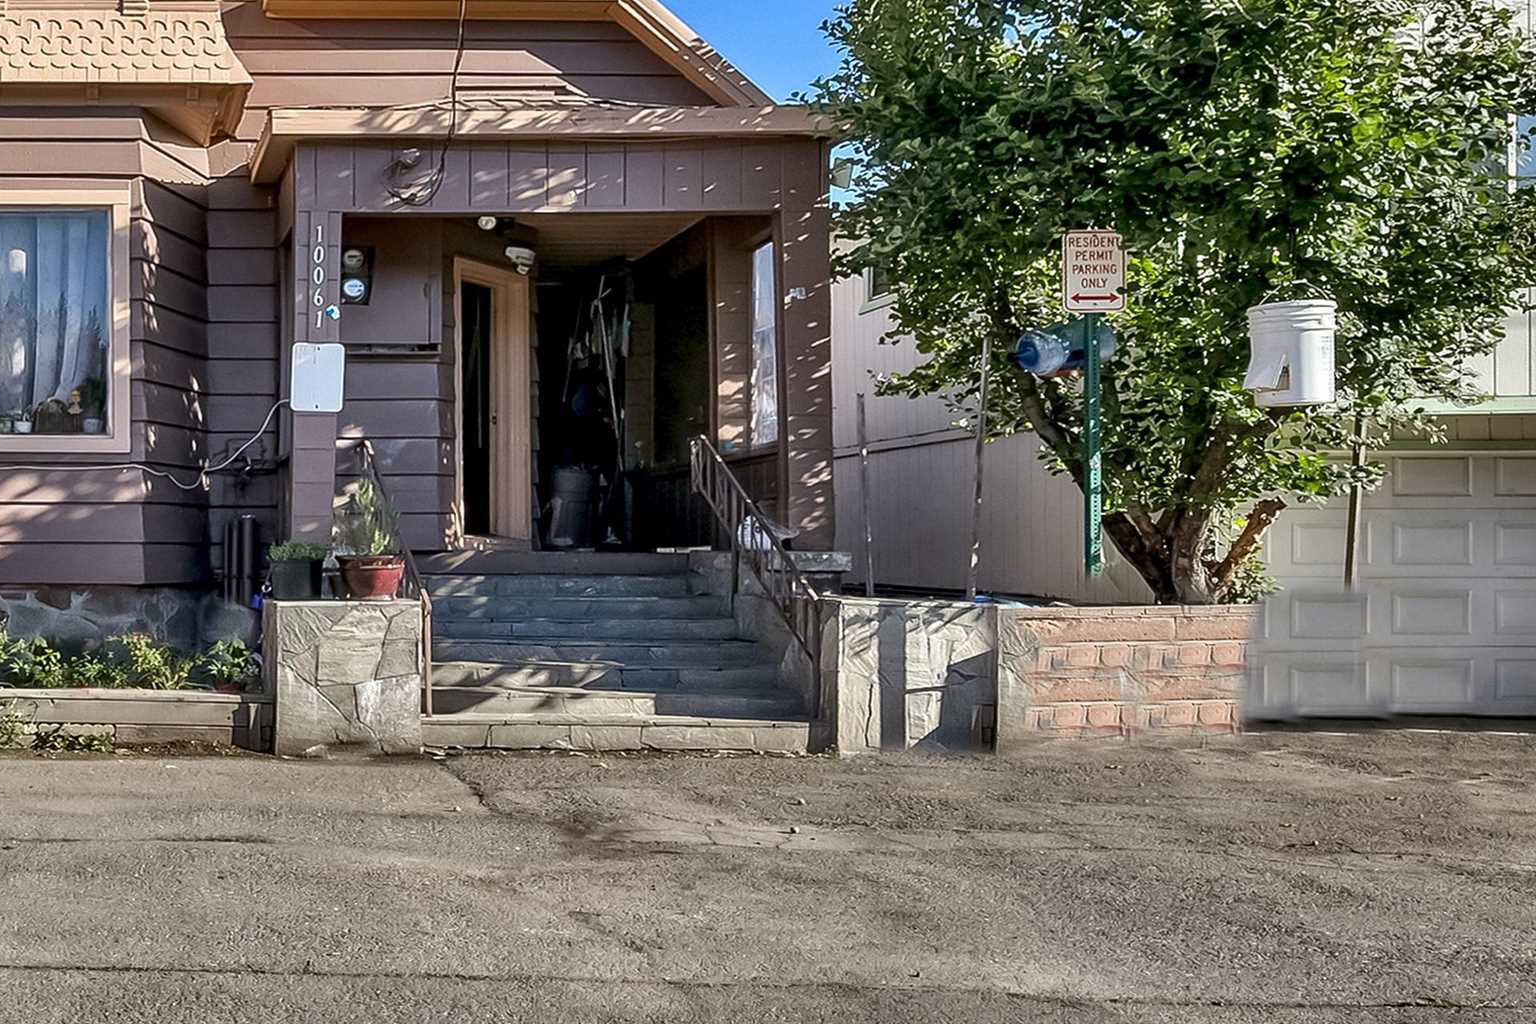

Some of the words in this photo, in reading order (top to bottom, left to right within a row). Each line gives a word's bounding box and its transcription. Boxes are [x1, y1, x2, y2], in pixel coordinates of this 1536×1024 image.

[1068, 237, 1120, 248] RESIDENT
[1075, 250, 1113, 261] PERMIT
[1072, 264, 1117, 274] PARKING
[313, 225, 325, 328] 10061
[1081, 278, 1108, 288] ONLY
